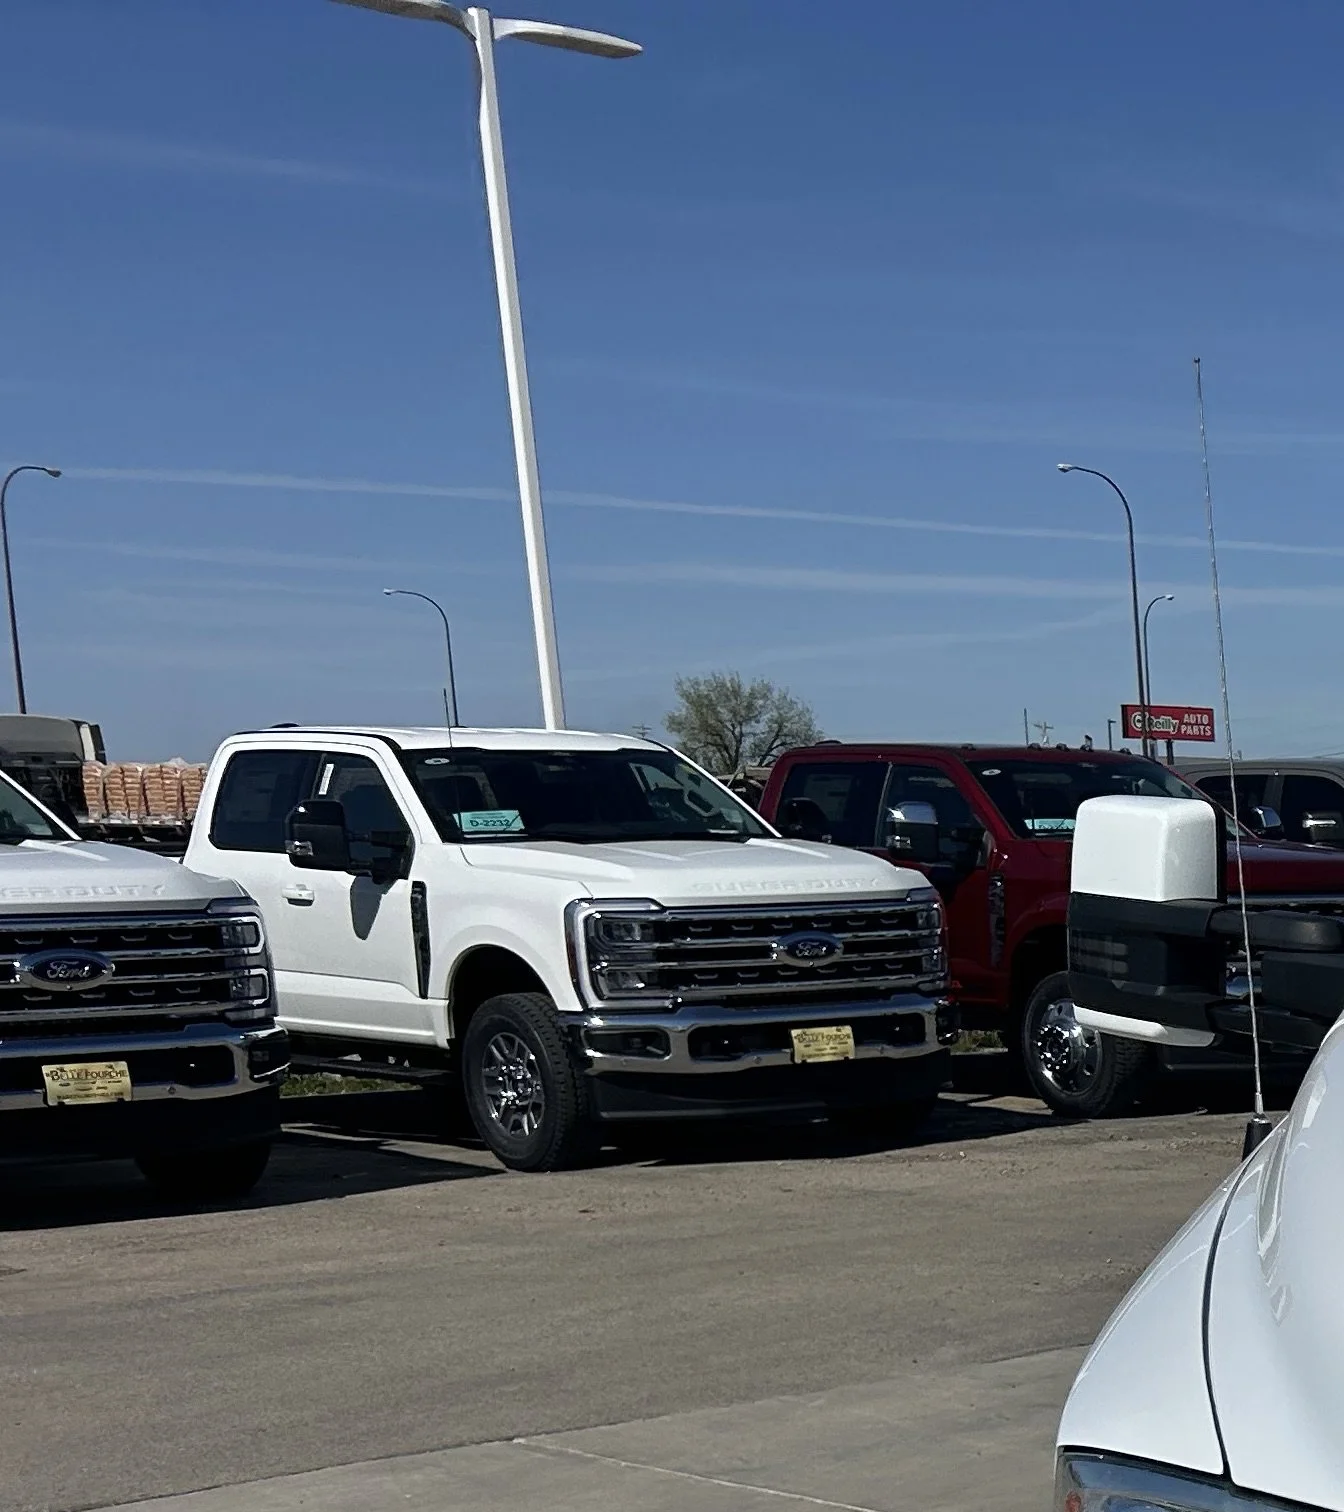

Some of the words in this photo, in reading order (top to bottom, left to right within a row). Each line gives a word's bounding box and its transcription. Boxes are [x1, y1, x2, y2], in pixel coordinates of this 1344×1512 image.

[1131, 712, 1180, 735] OReilly
[1183, 713, 1209, 725] AUTO
[1180, 724, 1212, 736] PARTS
[46, 960, 92, 979] Ford
